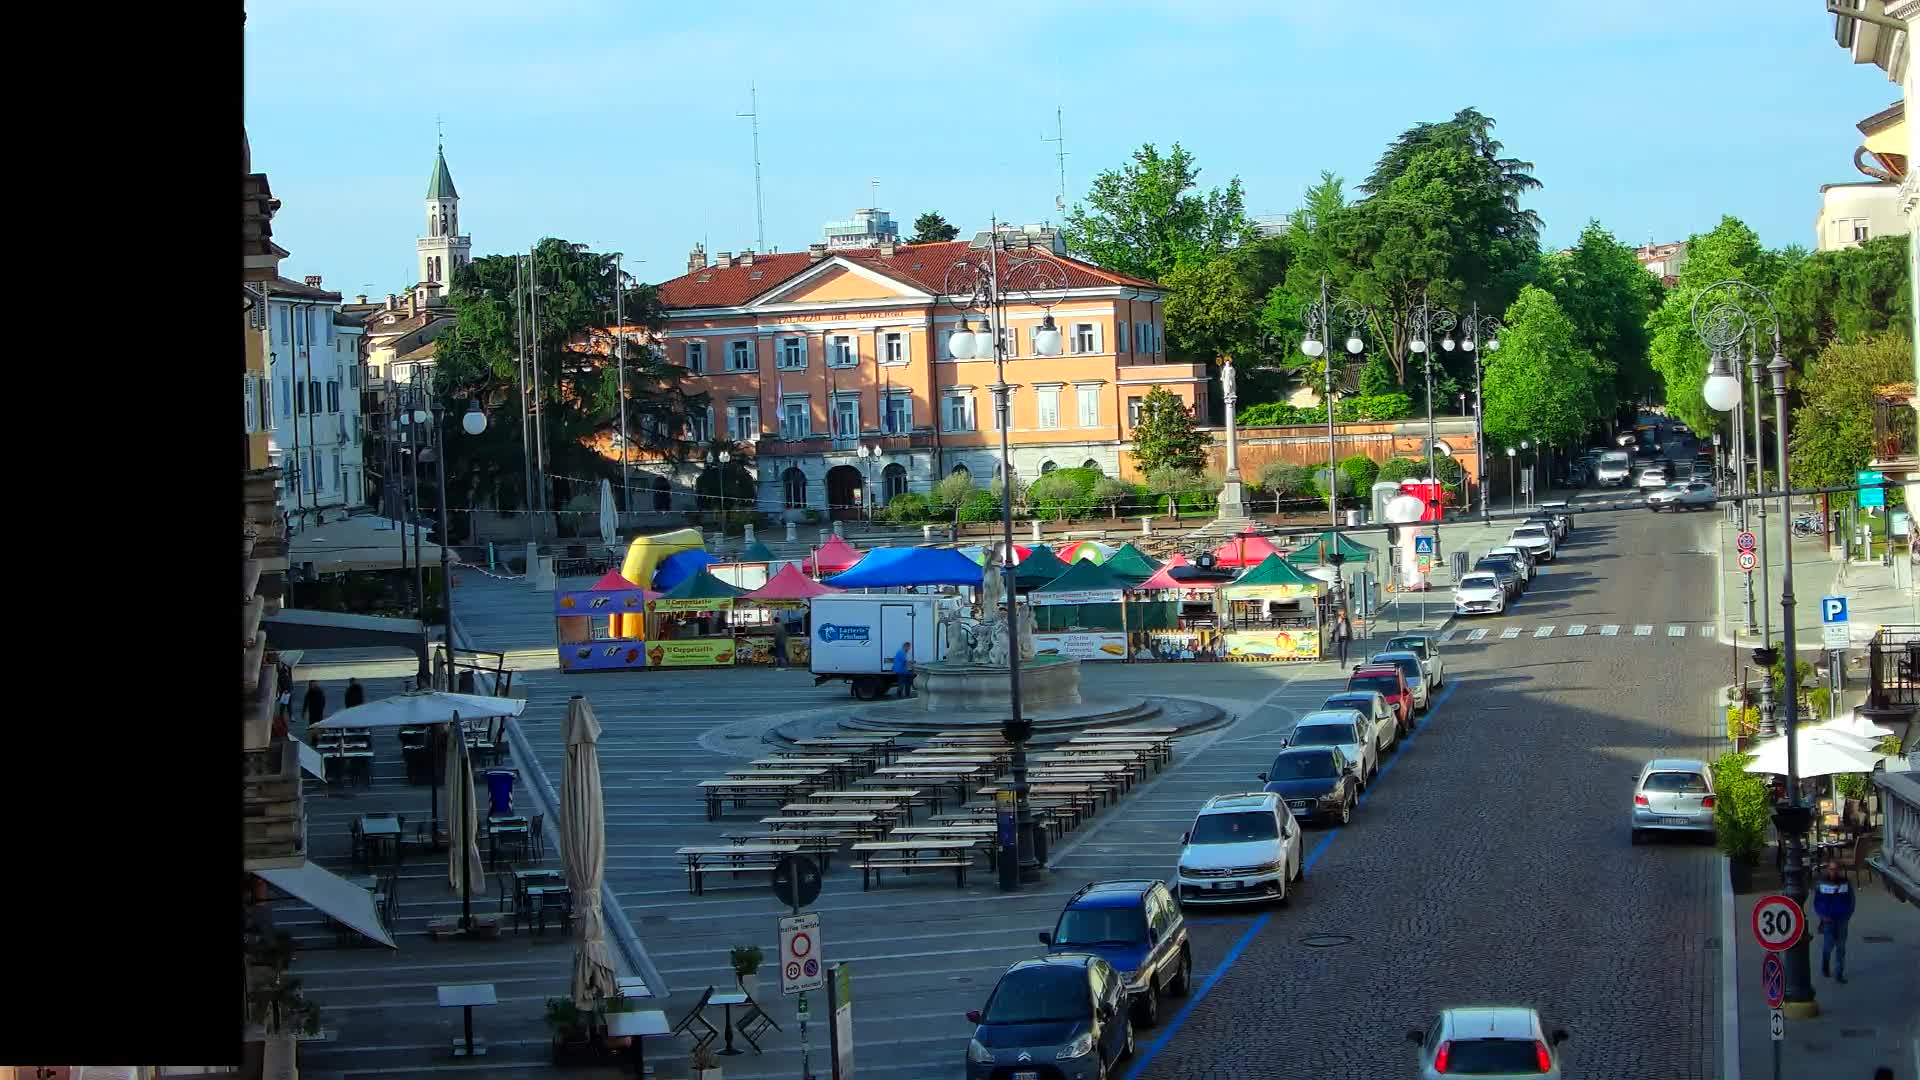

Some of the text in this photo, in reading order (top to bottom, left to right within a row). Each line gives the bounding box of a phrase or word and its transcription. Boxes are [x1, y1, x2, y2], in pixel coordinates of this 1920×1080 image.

[779, 313, 821, 324] PALAZZO
[831, 312, 849, 321] DEL
[1742, 556, 1753, 566] 20
[1827, 600, 1843, 621] P
[1762, 910, 1792, 936] 30
[789, 967, 797, 975] 20
